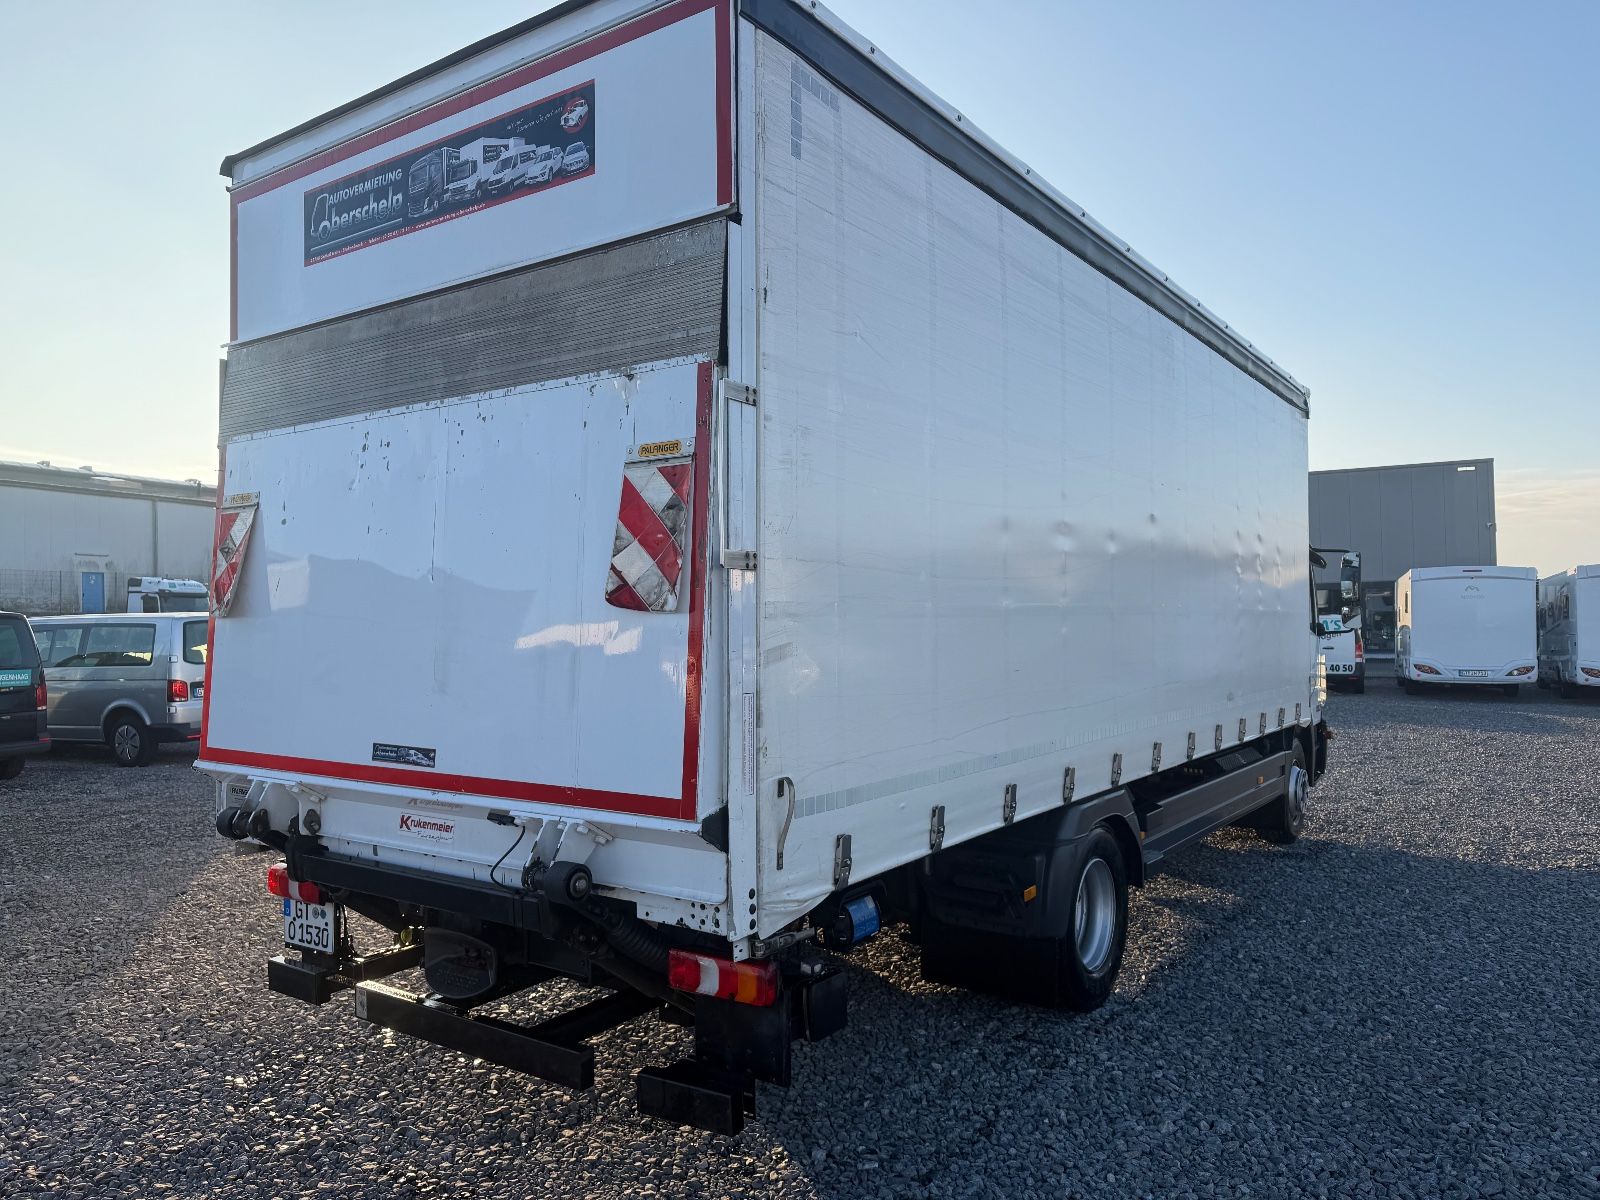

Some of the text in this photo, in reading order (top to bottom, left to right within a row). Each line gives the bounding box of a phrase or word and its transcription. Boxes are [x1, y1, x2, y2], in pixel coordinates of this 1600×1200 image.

[328, 168, 403, 206] AUTOVERMIETUNG
[318, 185, 403, 240] Oberschelp
[1329, 664, 1354, 673] 40 50
[400, 814, 454, 834] Krukenmeier
[295, 900, 311, 921] GT
